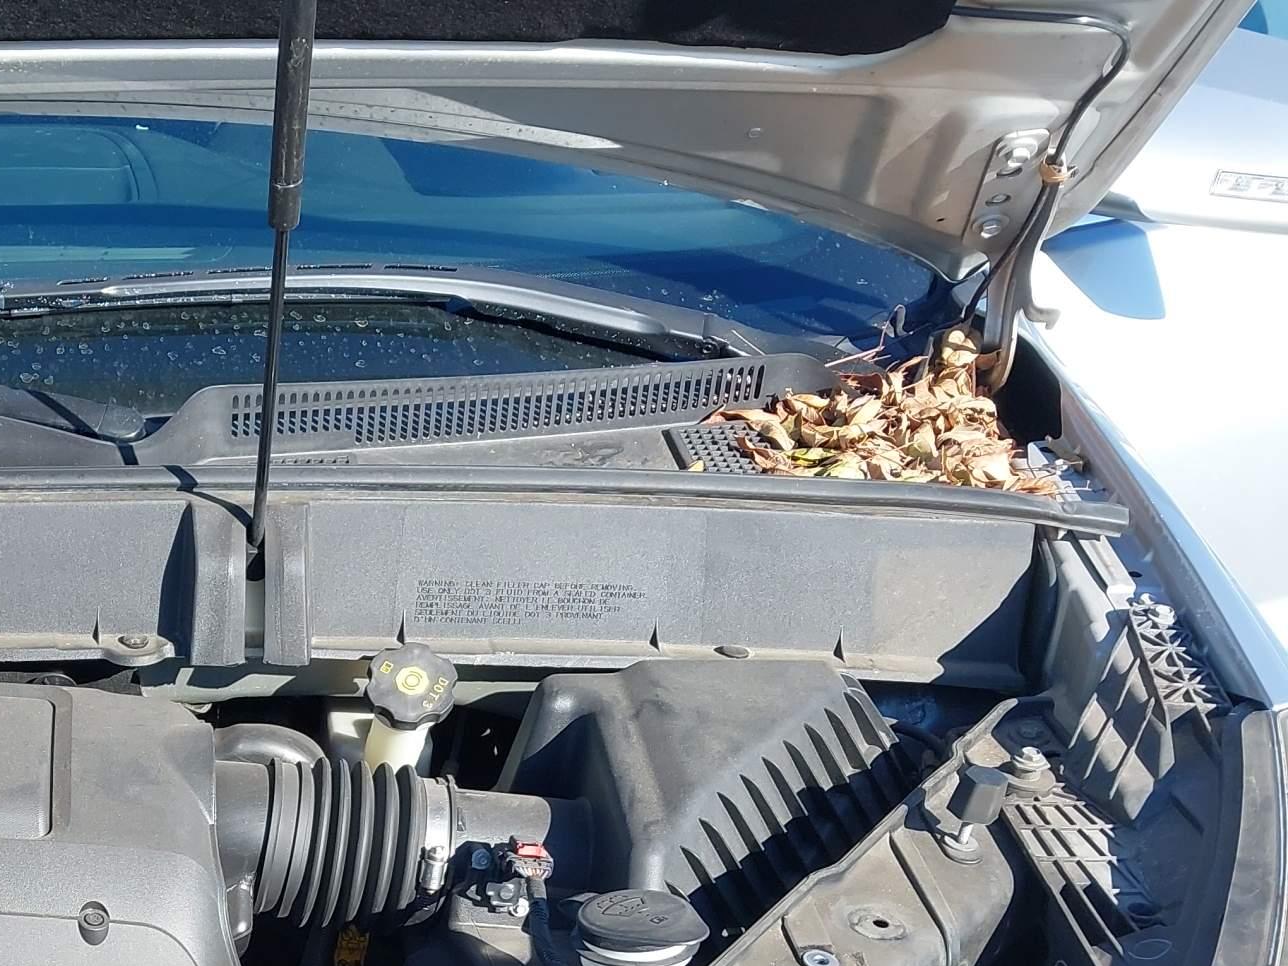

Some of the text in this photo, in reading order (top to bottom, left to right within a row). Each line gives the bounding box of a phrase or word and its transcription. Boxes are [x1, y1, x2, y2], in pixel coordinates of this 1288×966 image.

[465, 580, 492, 588] CLEAN
[496, 580, 529, 589] FILLER
[533, 581, 550, 589] CAP
[554, 582, 586, 590] BEFORE
[415, 586, 433, 594] USE
[437, 586, 460, 595] ONLY
[464, 587, 480, 595] DOT
[495, 588, 523, 596] FLUID
[527, 588, 550, 596] FROM
[564, 589, 597, 597] SEALED
[415, 600, 472, 609] REMPLISSAGE
[478, 602, 504, 610] AVANT
[509, 603, 520, 611] DE
[494, 595, 538, 604] NETTOYER
[557, 596, 594, 605] BOUCHON
[599, 597, 610, 606] DE
[414, 608, 462, 616] SEULEMENT
[466, 609, 479, 617] DU
[483, 610, 519, 618] LIQUIDE
[524, 610, 540, 618] DOT
[439, 616, 488, 625] CONTENANT
[422, 677, 449, 709] DOT 3
